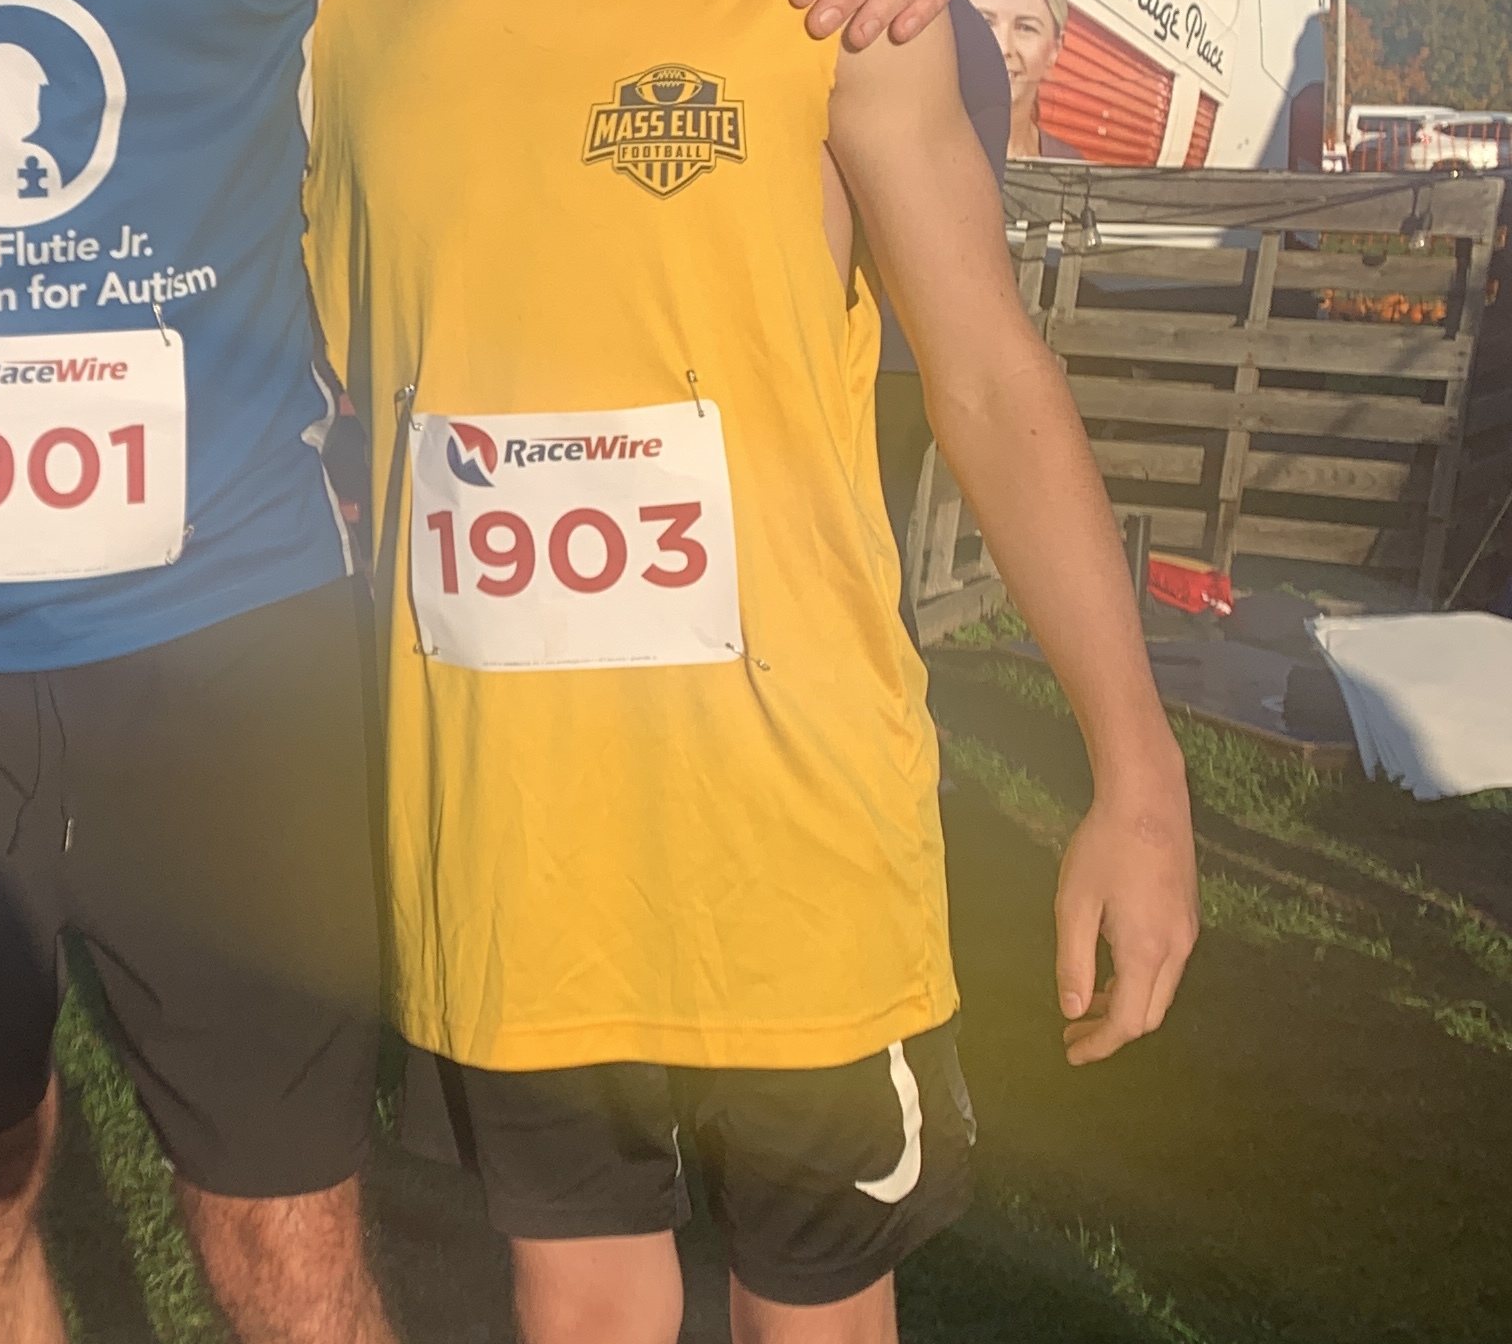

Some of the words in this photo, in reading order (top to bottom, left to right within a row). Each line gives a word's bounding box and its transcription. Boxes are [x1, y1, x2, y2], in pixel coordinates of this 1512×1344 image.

[1185, 2, 1224, 75] Place
[593, 111, 665, 147] MASS
[671, 111, 735, 144] ELITE
[621, 146, 702, 159] FOOTBALL
[109, 223, 154, 260] Jr.
[26, 275, 87, 311] for
[96, 263, 218, 309] Autism
[503, 434, 663, 468] RaceWire
[426, 501, 708, 598] 1903
